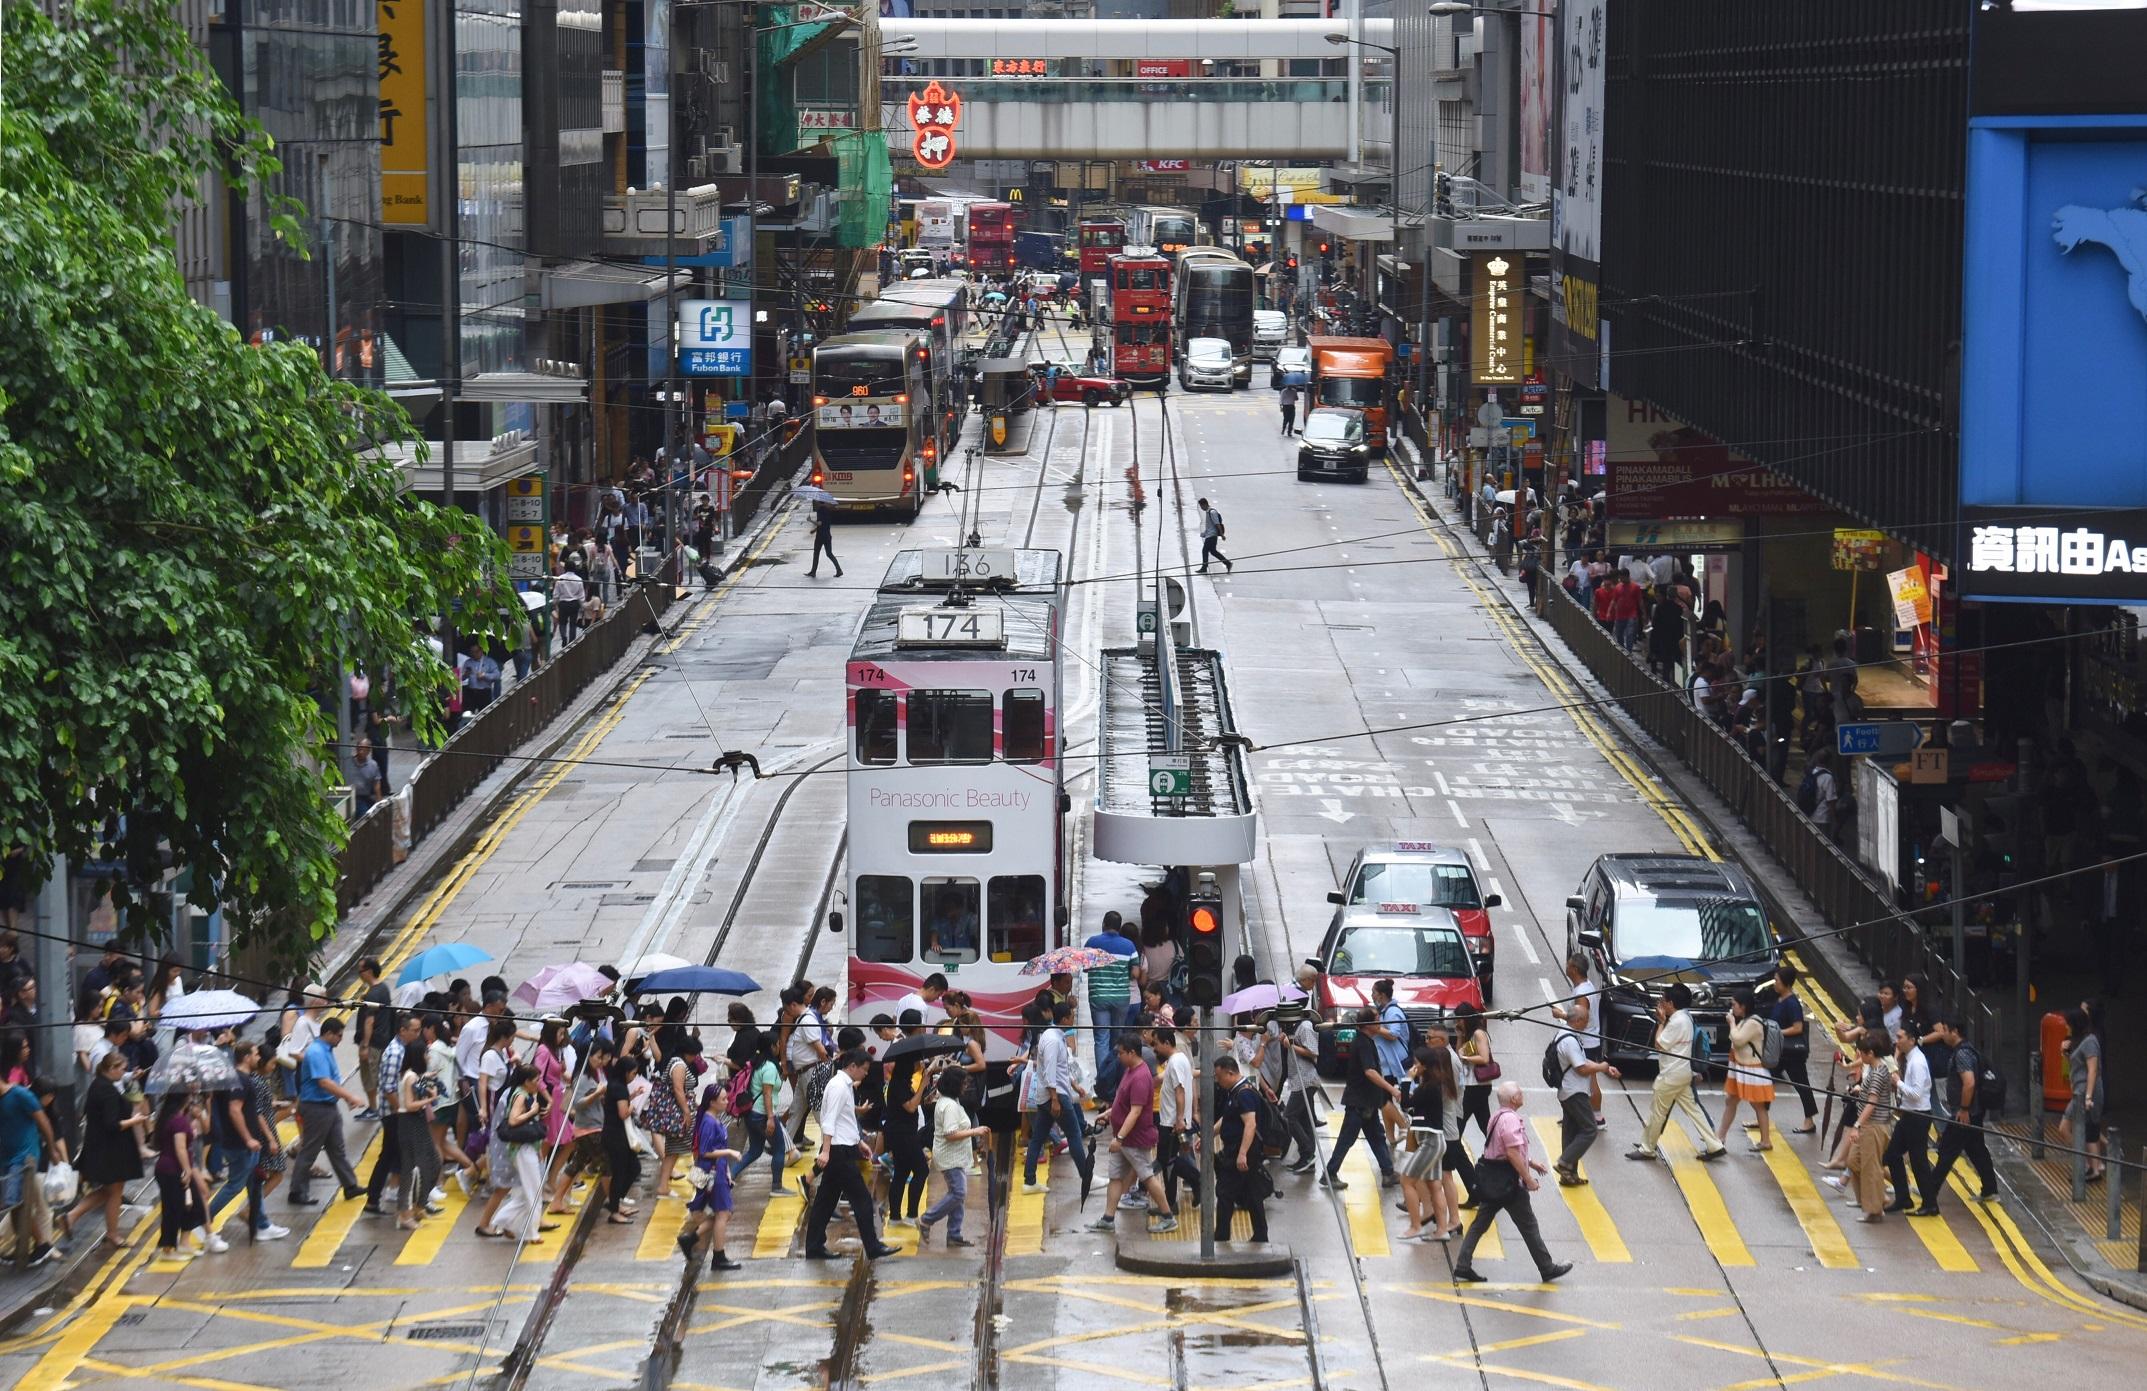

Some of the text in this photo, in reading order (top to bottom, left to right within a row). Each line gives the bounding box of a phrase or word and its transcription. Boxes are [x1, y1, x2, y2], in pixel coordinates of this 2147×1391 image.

[1140, 66, 1168, 74] OFFICE
[920, 131, 949, 161] 押
[1158, 160, 1184, 169] KFC
[691, 351, 742, 363] 富邦銀行
[691, 363, 741, 372] Fubon Bank
[832, 472, 853, 481] KMB
[520, 499, 540, 507] 8-10
[945, 554, 990, 576] 136
[922, 614, 981, 639] 174
[858, 669, 885, 681] 174
[1011, 669, 1036, 682] 174
[1915, 752, 1946, 771] FT
[1258, 772, 1400, 784] ROAD
[870, 787, 1031, 811] Panasonic Beauty
[1398, 842, 1432, 850] TAXI
[1381, 903, 1417, 912] TAXI
